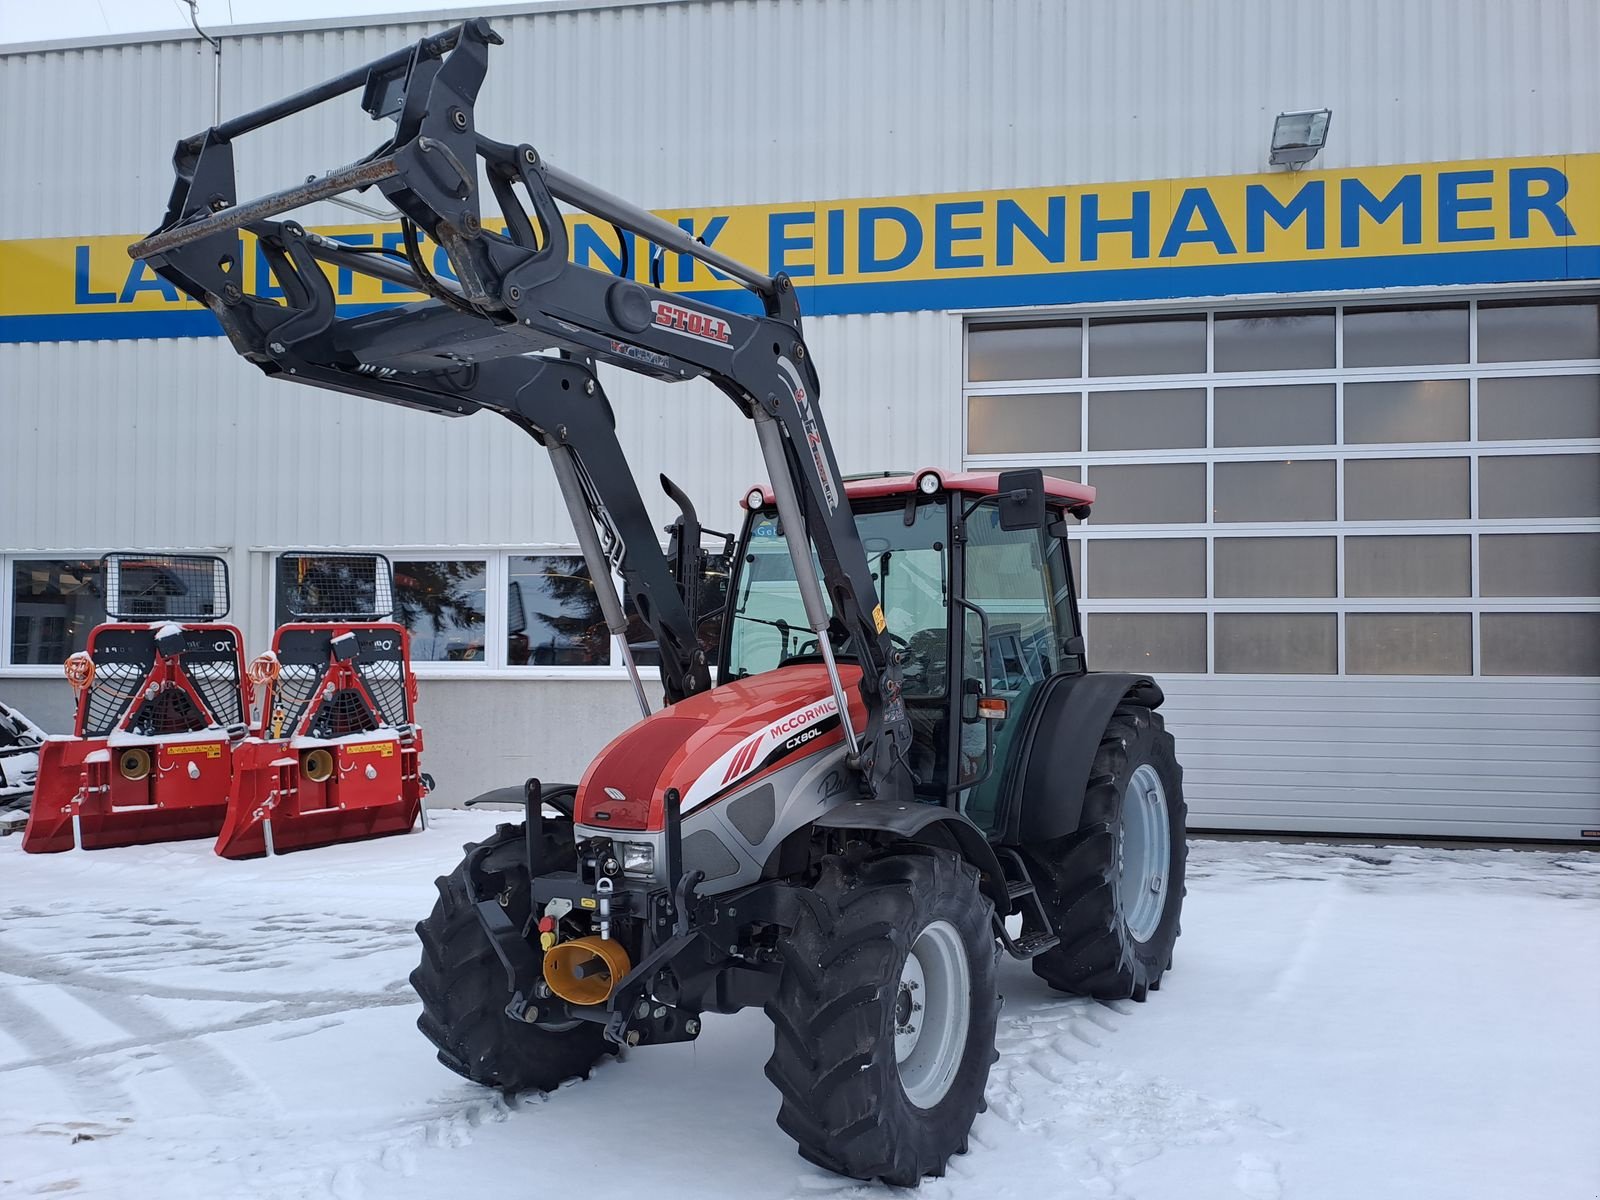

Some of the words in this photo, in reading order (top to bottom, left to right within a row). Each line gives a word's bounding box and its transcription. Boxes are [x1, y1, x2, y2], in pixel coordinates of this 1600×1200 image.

[75, 212, 729, 305] LATENK
[768, 166, 1577, 279] EIDENHAMMER
[656, 303, 729, 343] STOLL
[770, 701, 837, 739] McCORMIC
[786, 728, 822, 749] CX80L
